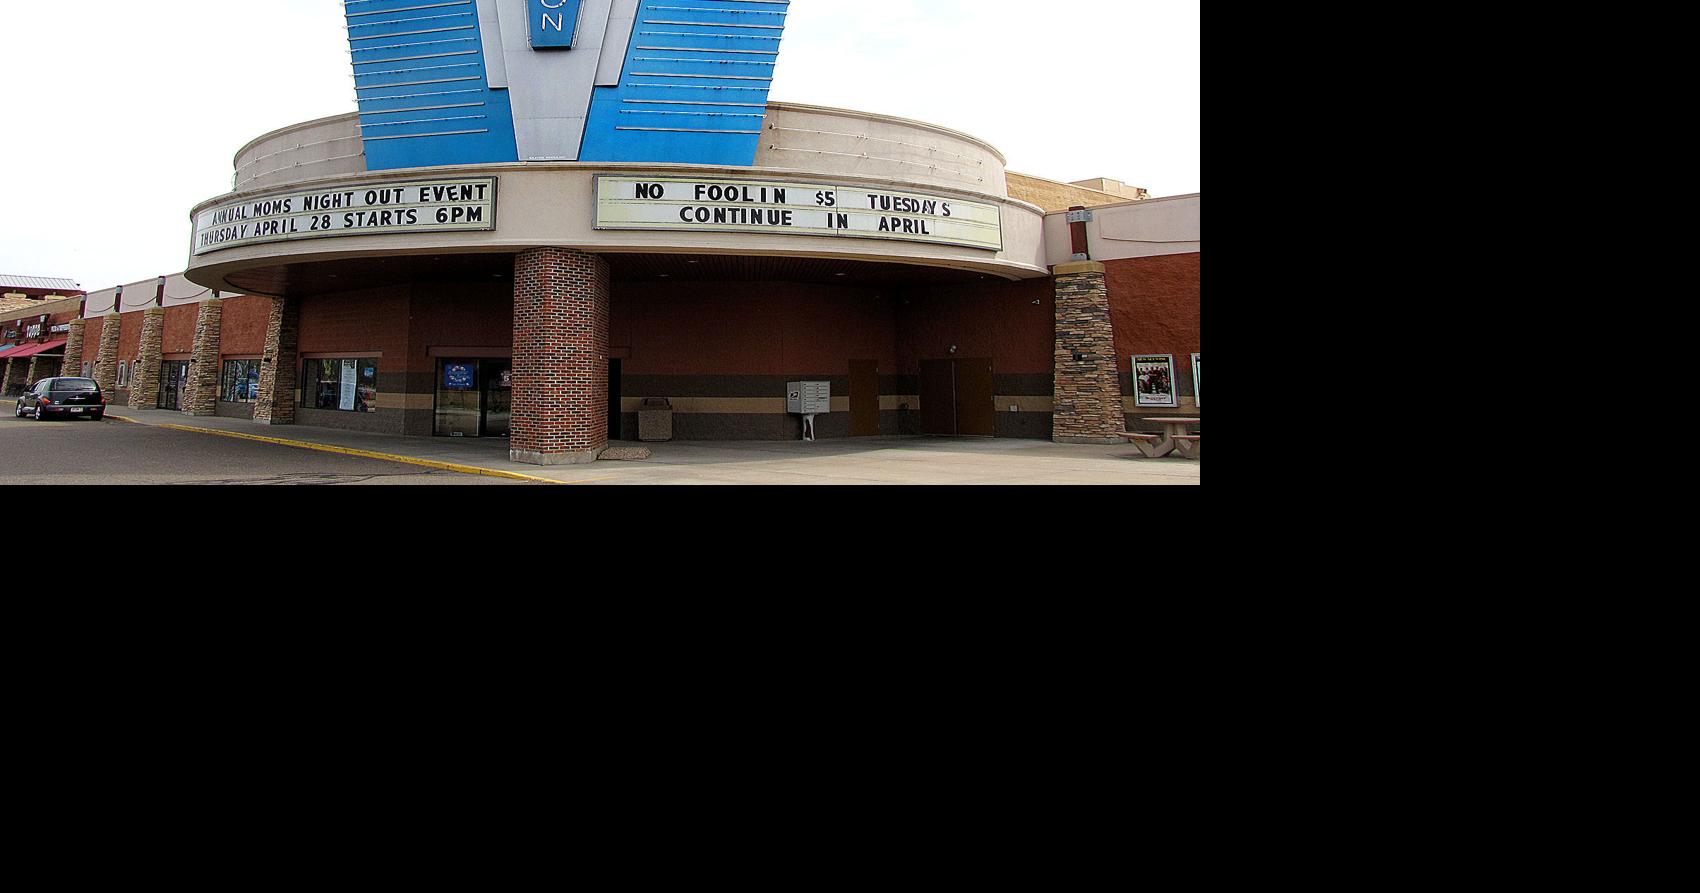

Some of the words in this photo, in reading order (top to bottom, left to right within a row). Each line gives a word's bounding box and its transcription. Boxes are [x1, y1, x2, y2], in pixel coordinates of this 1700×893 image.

[212, 205, 248, 226] ANNUAL
[253, 198, 292, 218] MOMS
[303, 191, 355, 212] NIGHT
[364, 188, 405, 206] OUT
[419, 183, 488, 203] EVENT
[634, 182, 665, 200] NO
[815, 189, 836, 208] $5
[200, 223, 248, 247] THURSDAY
[253, 217, 298, 238] APRIL
[309, 214, 332, 231] 28
[343, 208, 418, 229] STARTS
[435, 206, 483, 224] 6PM
[679, 205, 793, 227] CONTINUE
[826, 212, 850, 230] IN
[878, 215, 931, 236] APRIL
